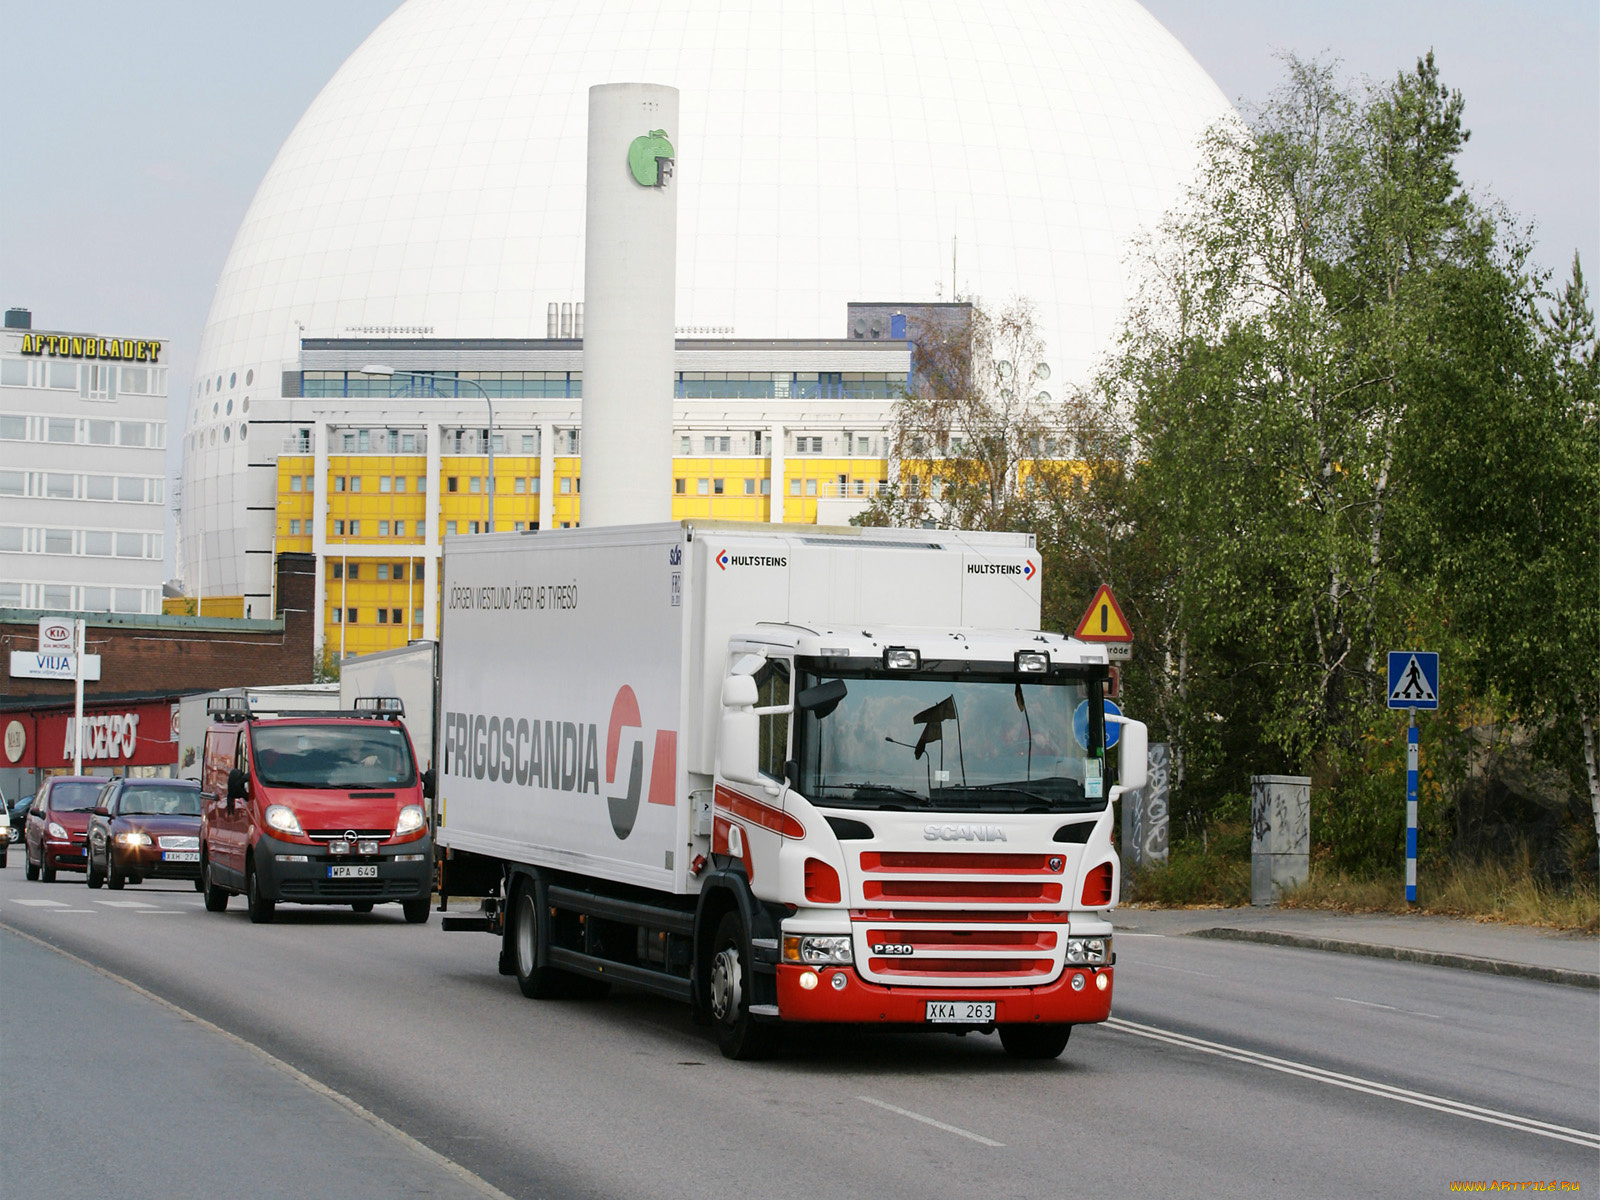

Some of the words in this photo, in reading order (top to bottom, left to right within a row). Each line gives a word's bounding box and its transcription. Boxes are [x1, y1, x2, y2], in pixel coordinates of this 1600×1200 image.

[21, 333, 161, 362] AFTONBLADET
[731, 556, 787, 567] HULTSTEINS
[967, 564, 1022, 575] HULTSTEINS
[449, 581, 474, 609] JÖRGEN
[476, 586, 511, 609] WESTLUND
[536, 586, 545, 609] AB
[548, 578, 578, 609] TYRESÖ
[50, 629, 66, 637] KIA
[36, 655, 71, 671] VILJA
[444, 711, 599, 795] FRIGOSCANDIA
[923, 824, 1008, 842] SCANIA
[333, 867, 351, 877] WPA
[357, 866, 376, 877] 649
[874, 944, 884, 954] P
[885, 944, 912, 954] 230
[930, 1004, 955, 1018] XKA
[966, 1004, 992, 1018] 263
